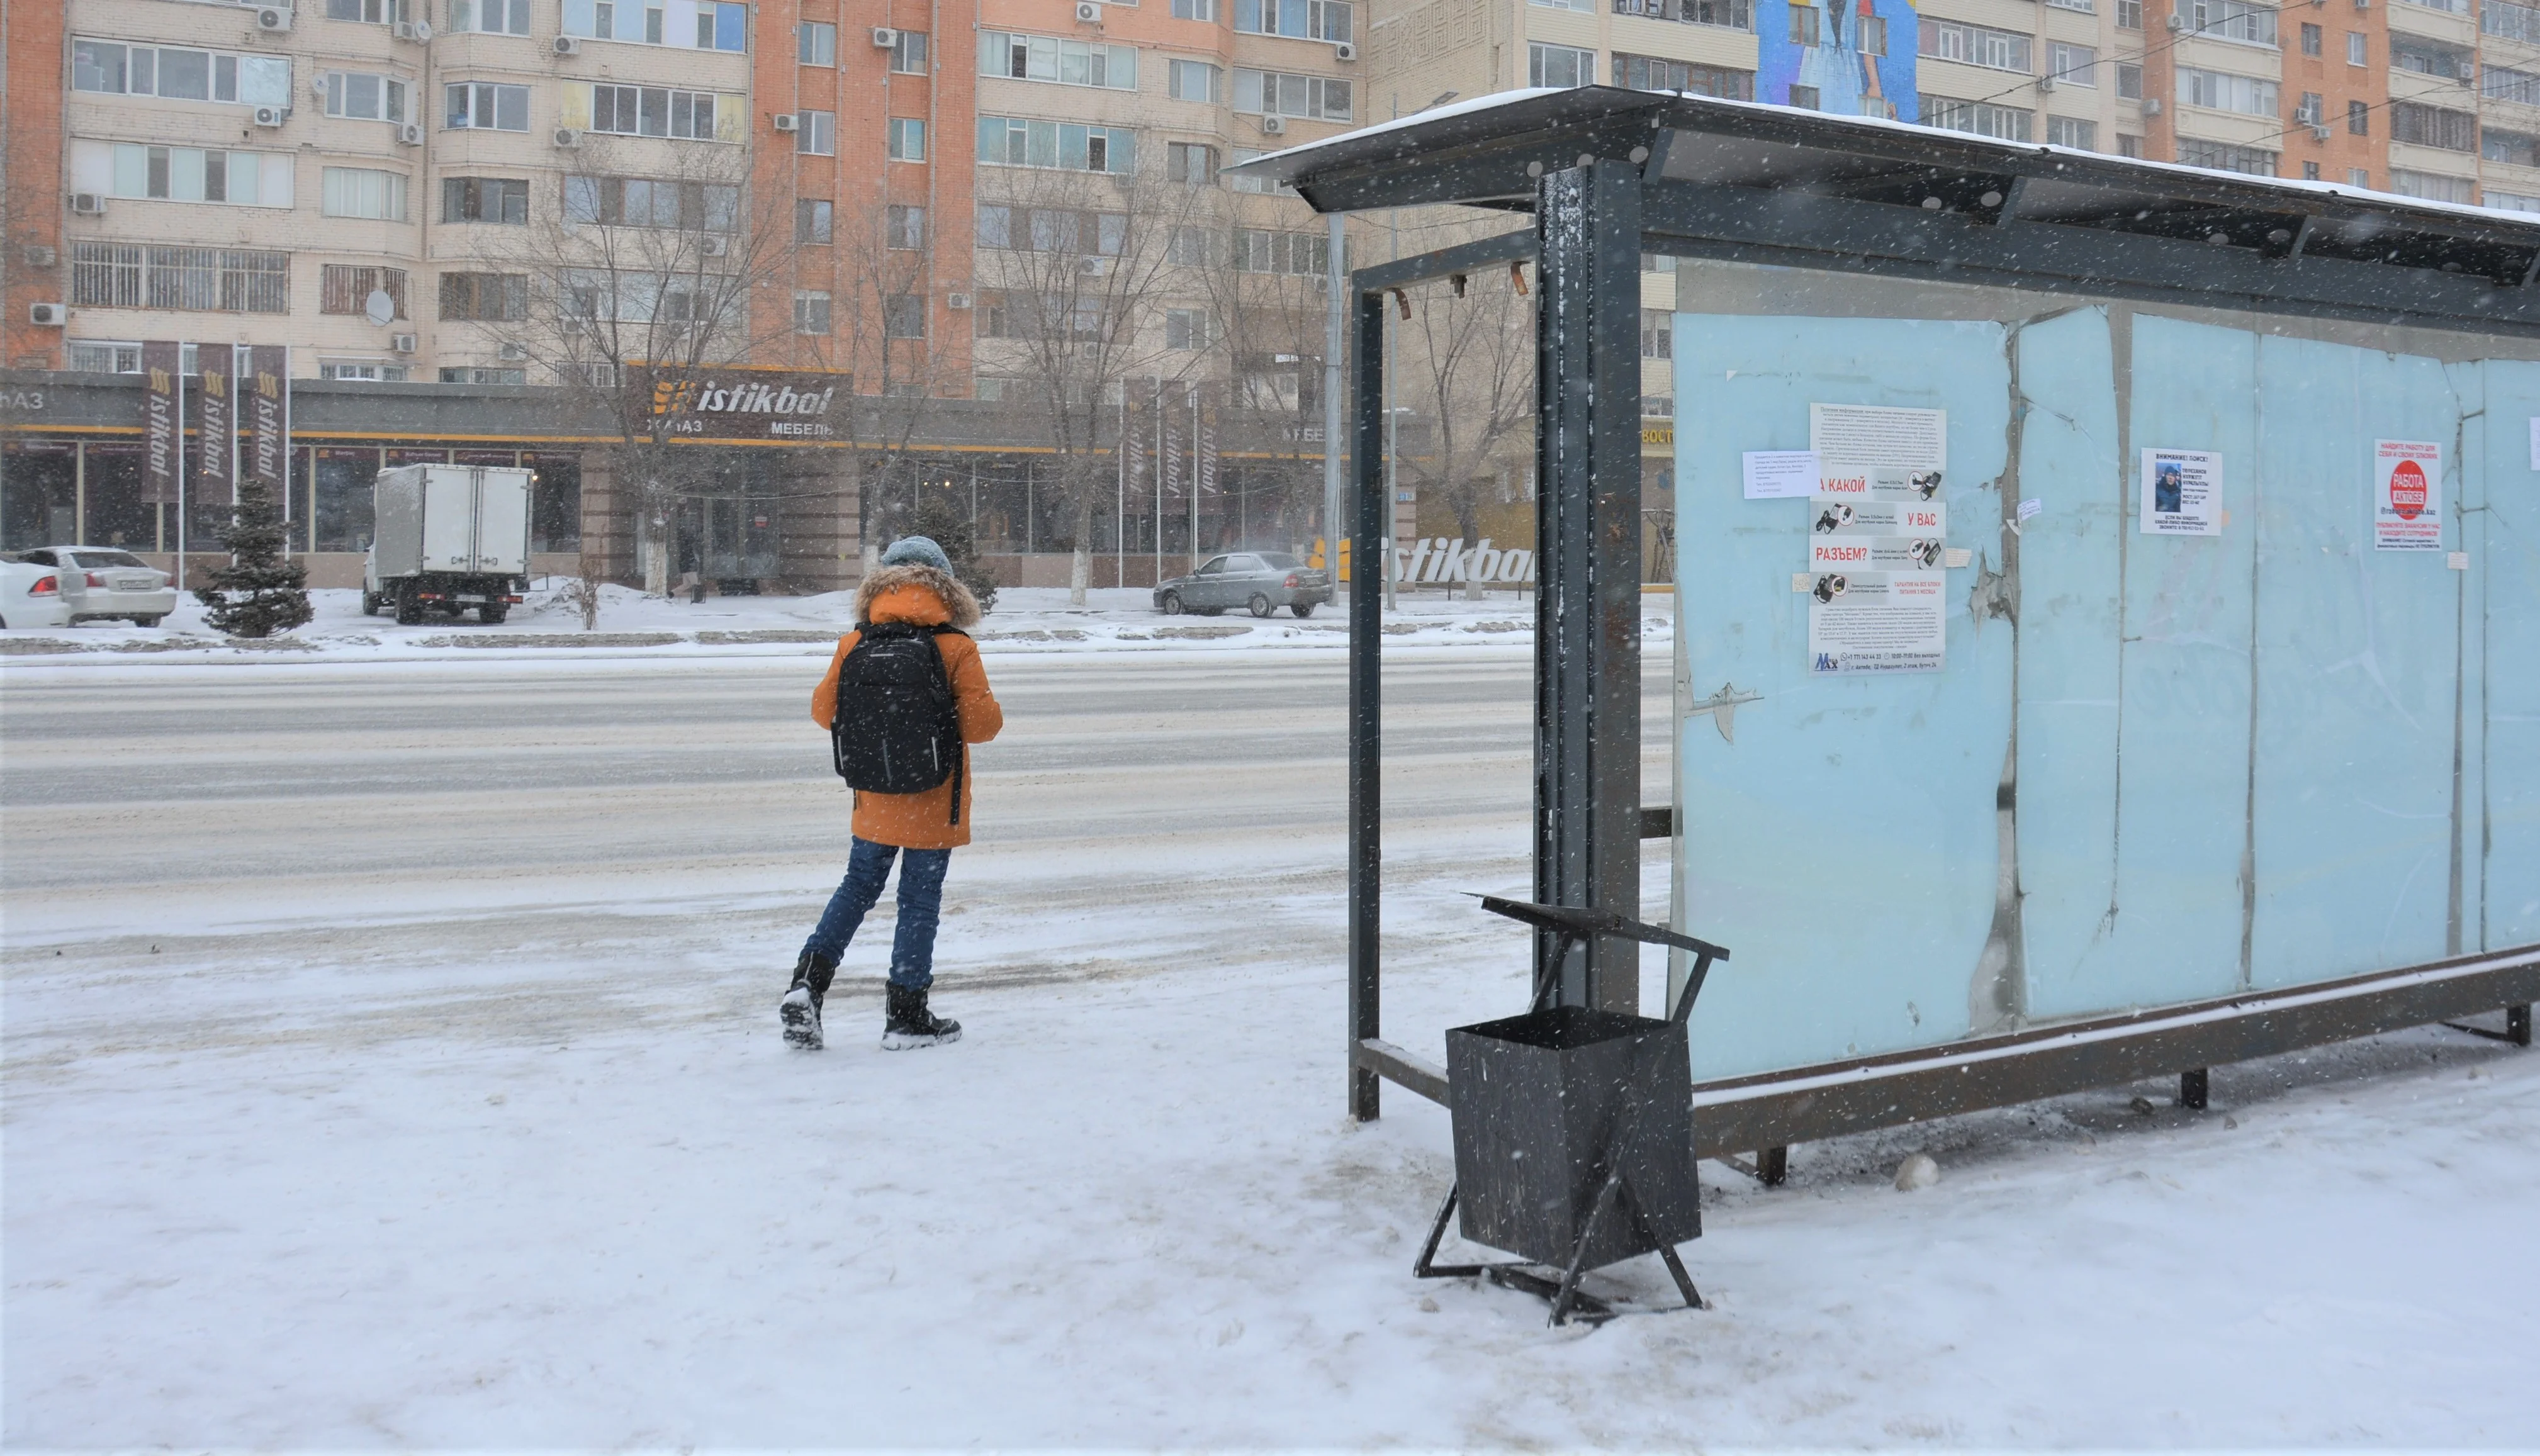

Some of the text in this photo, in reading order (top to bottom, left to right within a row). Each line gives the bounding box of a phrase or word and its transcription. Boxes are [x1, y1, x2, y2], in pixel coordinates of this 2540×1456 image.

[697, 381, 834, 415] istikbal
[150, 395, 171, 477] istikbal
[205, 397, 225, 478] istikbal
[258, 398, 278, 479] istikbal
[1829, 476, 1865, 493] КАКОЙ
[2393, 473, 2424, 488] РАБОТА
[1908, 512, 1936, 526] У ВАС
[1381, 537, 1536, 583] stikba
[1816, 547, 1867, 561] РАЗЪЕМ?
